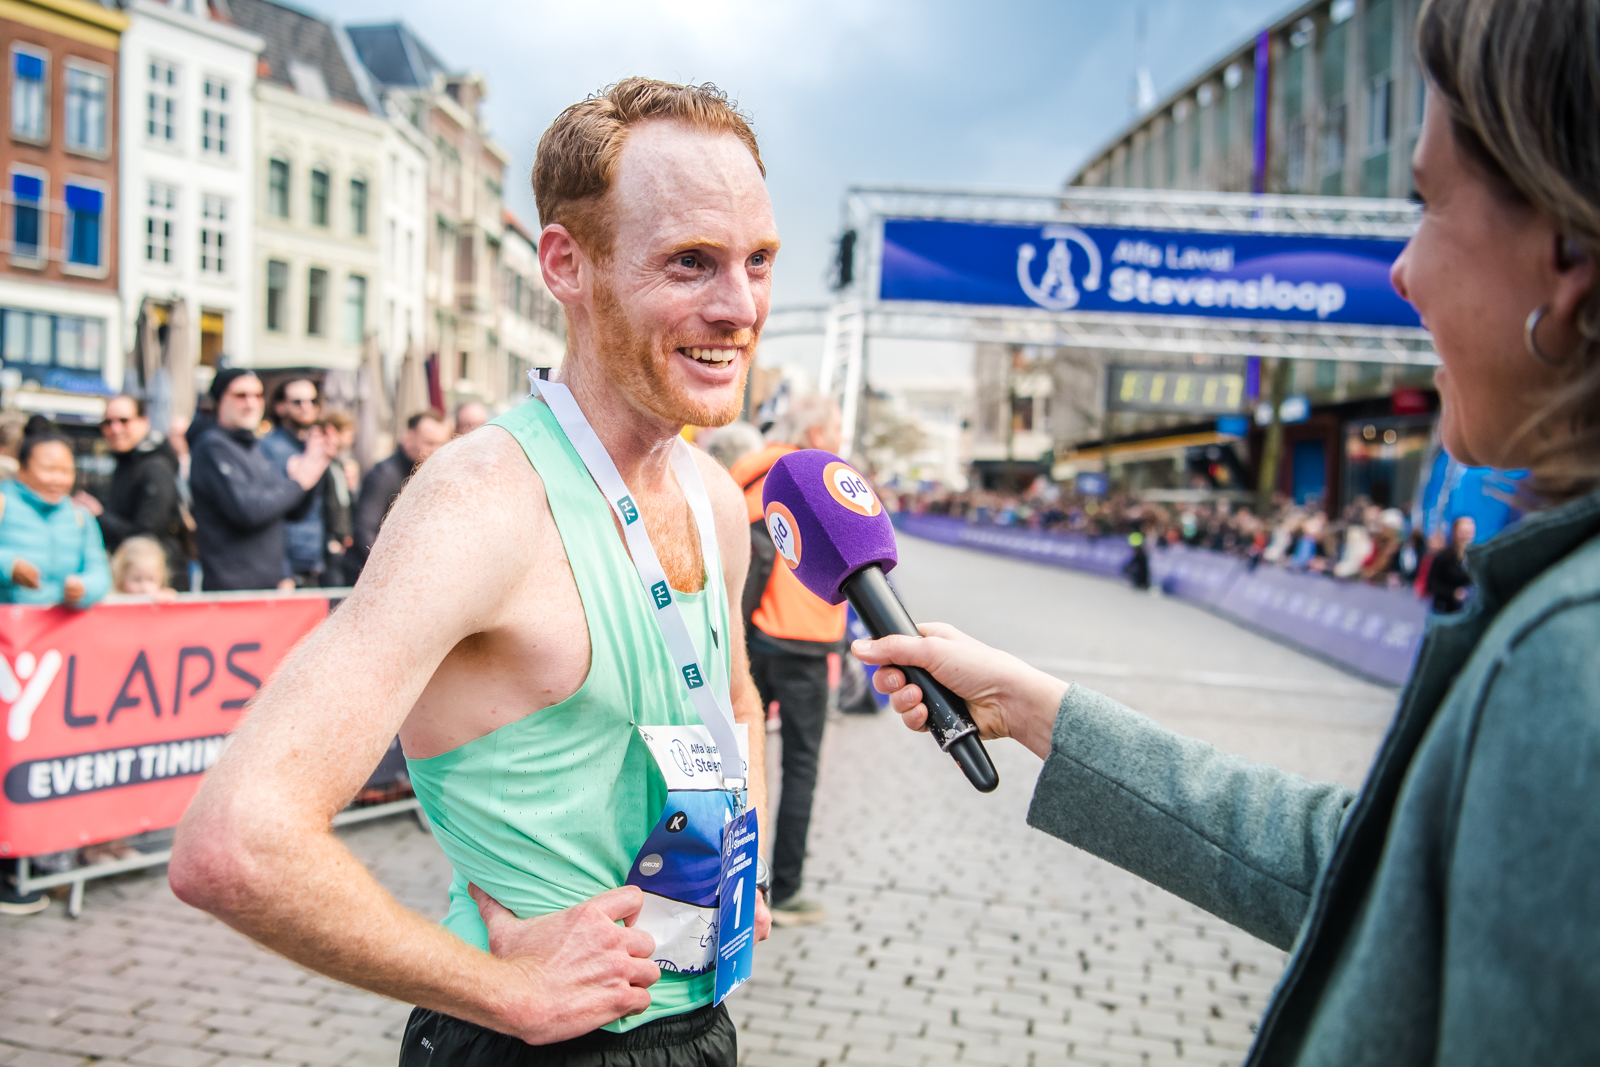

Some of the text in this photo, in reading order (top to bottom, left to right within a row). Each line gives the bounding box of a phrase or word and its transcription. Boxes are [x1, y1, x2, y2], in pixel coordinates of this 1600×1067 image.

[1112, 239, 1235, 272] Alfa Laval
[1108, 266, 1346, 319] Stevensloop
[840, 476, 868, 498] gld
[28, 735, 225, 798] EVENT TIMIN
[670, 816, 684, 830] K
[733, 877, 744, 929] 1
